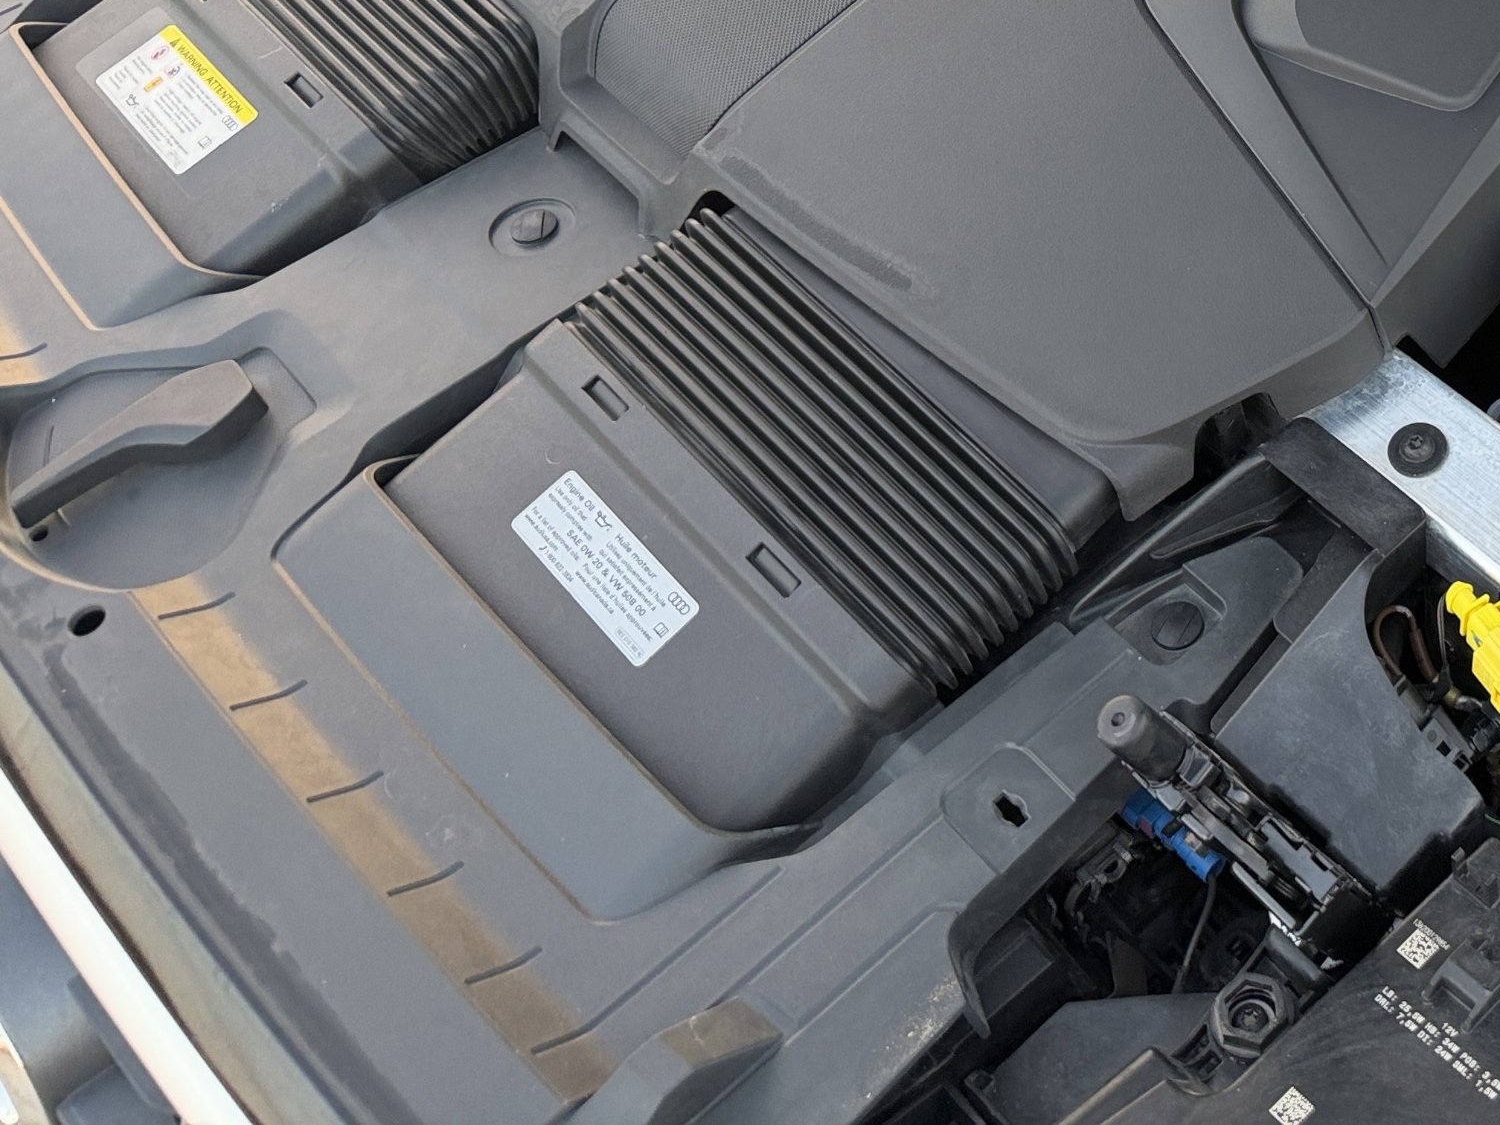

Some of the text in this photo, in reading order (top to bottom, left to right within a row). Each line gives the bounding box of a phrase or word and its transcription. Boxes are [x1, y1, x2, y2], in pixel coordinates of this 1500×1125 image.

[177, 44, 207, 76] WARNING
[206, 74, 242, 114] ATTENTION
[562, 478, 595, 511] Engine Oil
[566, 529, 582, 546] SAE
[601, 568, 609, 576] &
[608, 575, 623, 591] VW
[634, 605, 645, 616] 00
[615, 534, 656, 579] Huile moteur
[1441, 1022, 1457, 1038] 12V
[1442, 1037, 1459, 1053] 34W
[1434, 1045, 1452, 1061] 24W
